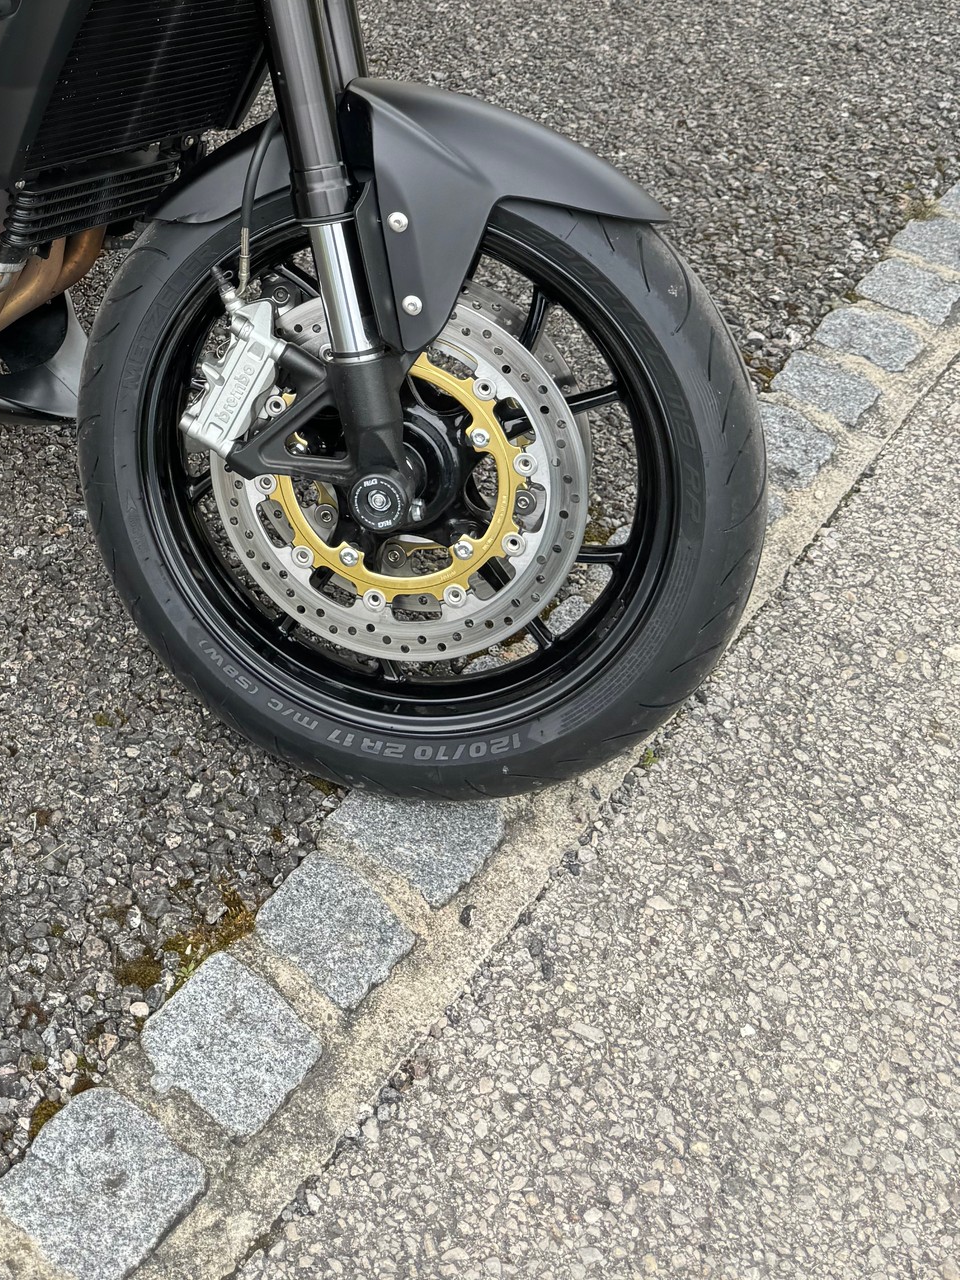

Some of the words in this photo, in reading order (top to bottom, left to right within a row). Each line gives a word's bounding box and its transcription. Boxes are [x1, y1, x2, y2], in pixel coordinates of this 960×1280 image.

[121, 244, 220, 390] METZELER
[524, 225, 674, 375] SPORTEC
[214, 364, 256, 424] brembo
[198, 639, 260, 696] (58W)
[326, 728, 354, 748] 17
[361, 739, 405, 761] ZR
[413, 732, 522, 762] 120/70
